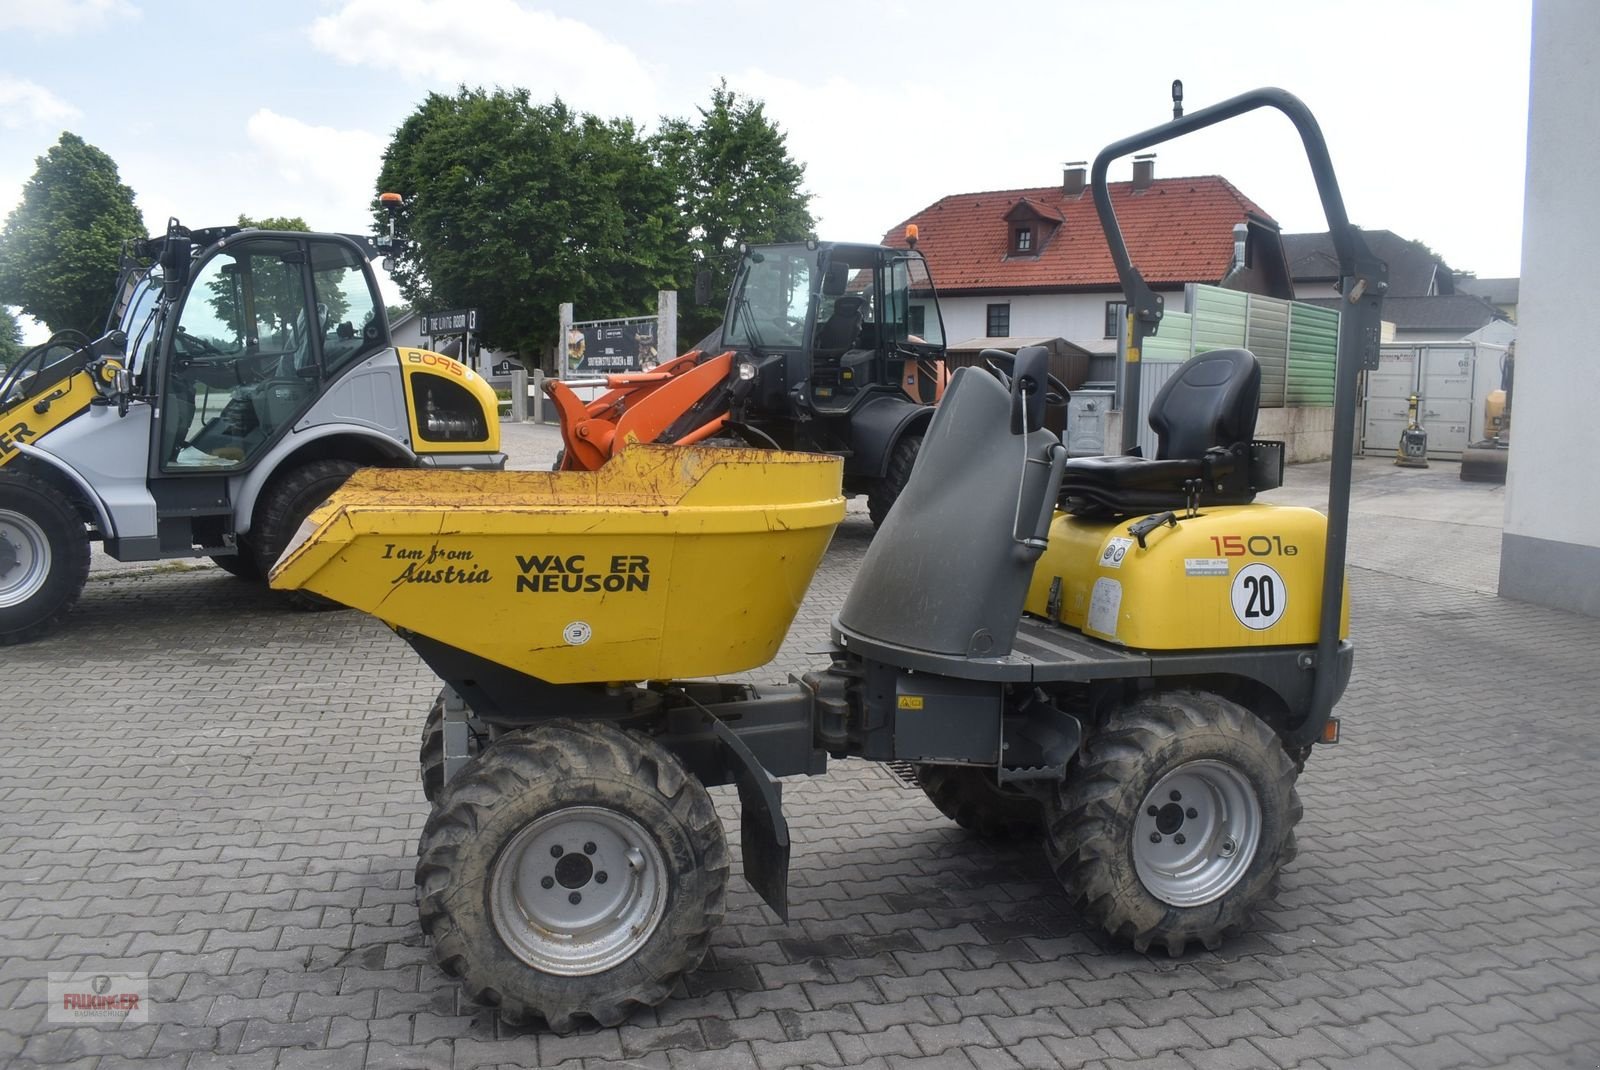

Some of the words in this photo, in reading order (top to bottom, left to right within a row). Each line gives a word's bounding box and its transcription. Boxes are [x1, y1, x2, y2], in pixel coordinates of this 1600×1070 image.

[430, 318, 438, 331] THE
[453, 314, 466, 328] ROOM
[408, 352, 463, 376] 8095
[0, 422, 37, 458] ER
[396, 547, 425, 560] am
[427, 542, 474, 562] from
[391, 564, 493, 584] Austria
[516, 574, 650, 593] NEUSON
[1243, 575, 1275, 618] 20
